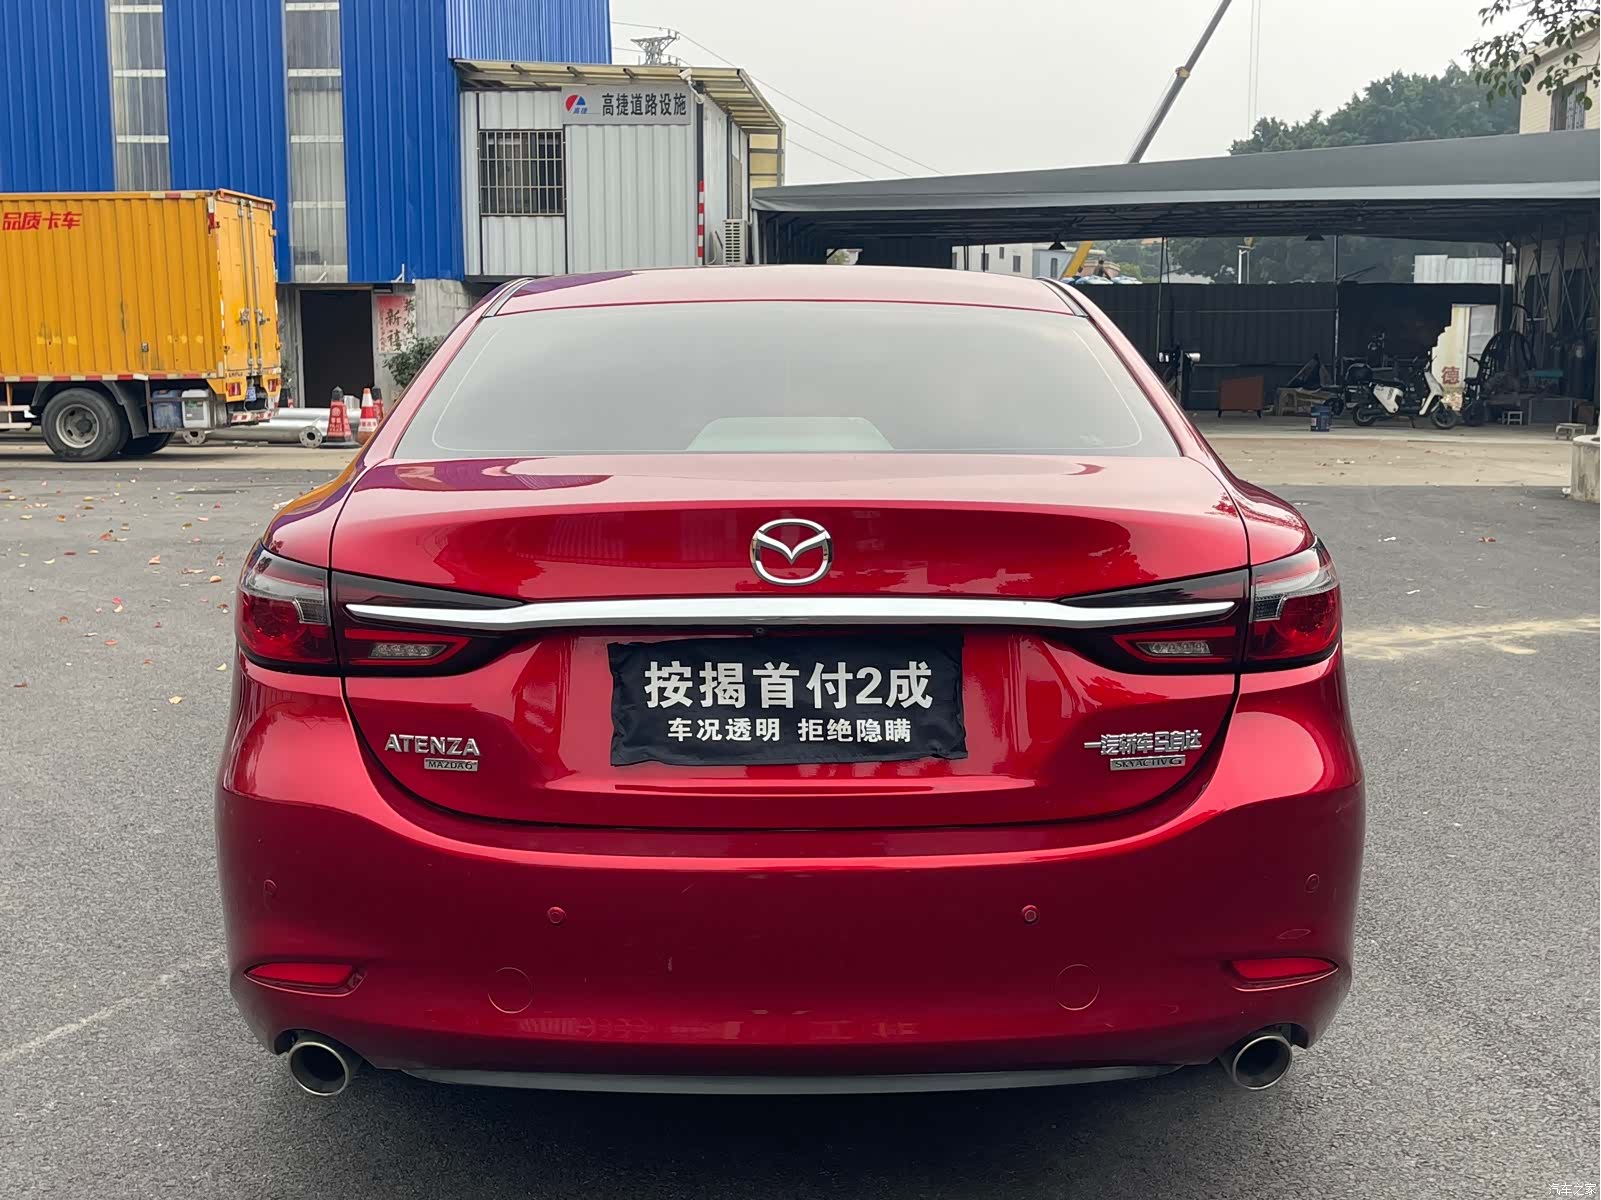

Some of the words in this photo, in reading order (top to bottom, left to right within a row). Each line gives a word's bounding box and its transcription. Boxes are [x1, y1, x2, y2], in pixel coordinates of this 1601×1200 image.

[601, 92, 687, 116] 高捷道路设施
[2, 211, 82, 231] 品质卡车
[1441, 366, 1460, 384] 德
[644, 660, 933, 710] 按揭首付2成
[667, 717, 781, 743] 车况透明
[797, 717, 912, 743] 拒绝隐瞒
[384, 733, 481, 757] ATENZA
